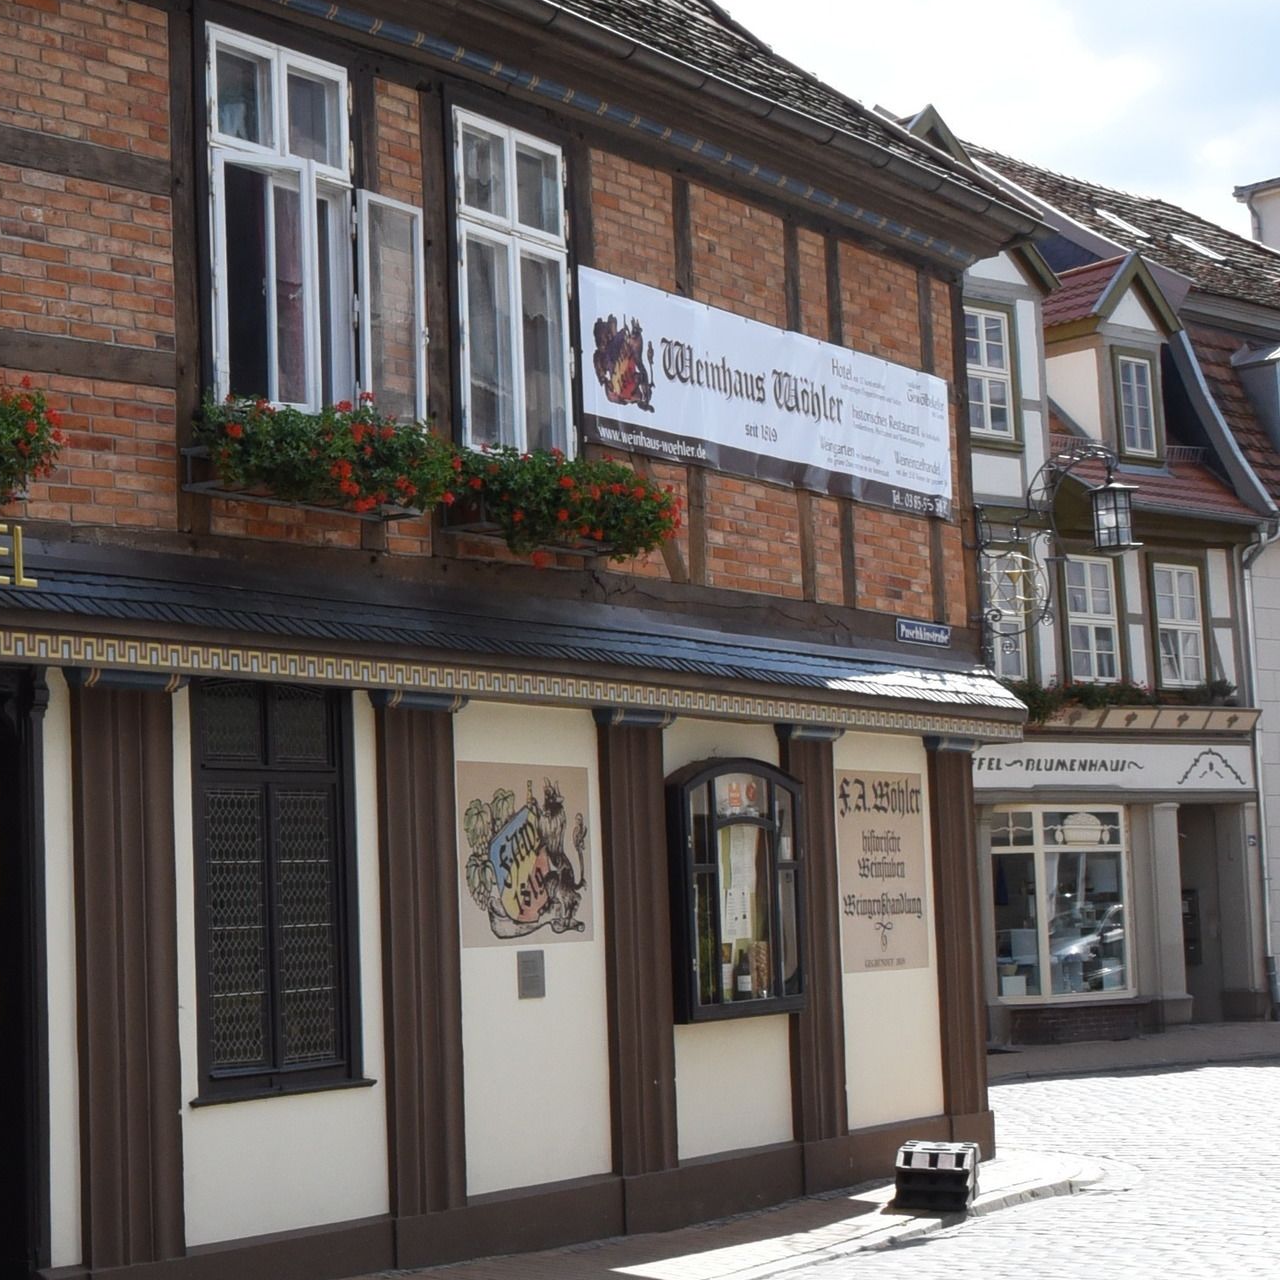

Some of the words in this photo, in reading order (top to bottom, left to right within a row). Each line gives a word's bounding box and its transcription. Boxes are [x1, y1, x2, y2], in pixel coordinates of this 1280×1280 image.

[660, 337, 767, 403] Weinhaus
[772, 368, 844, 424] Wöhler
[831, 358, 852, 380] Hotel
[598, 424, 707, 460] www.weinhaus-woehler.de
[745, 422, 759, 438] seit
